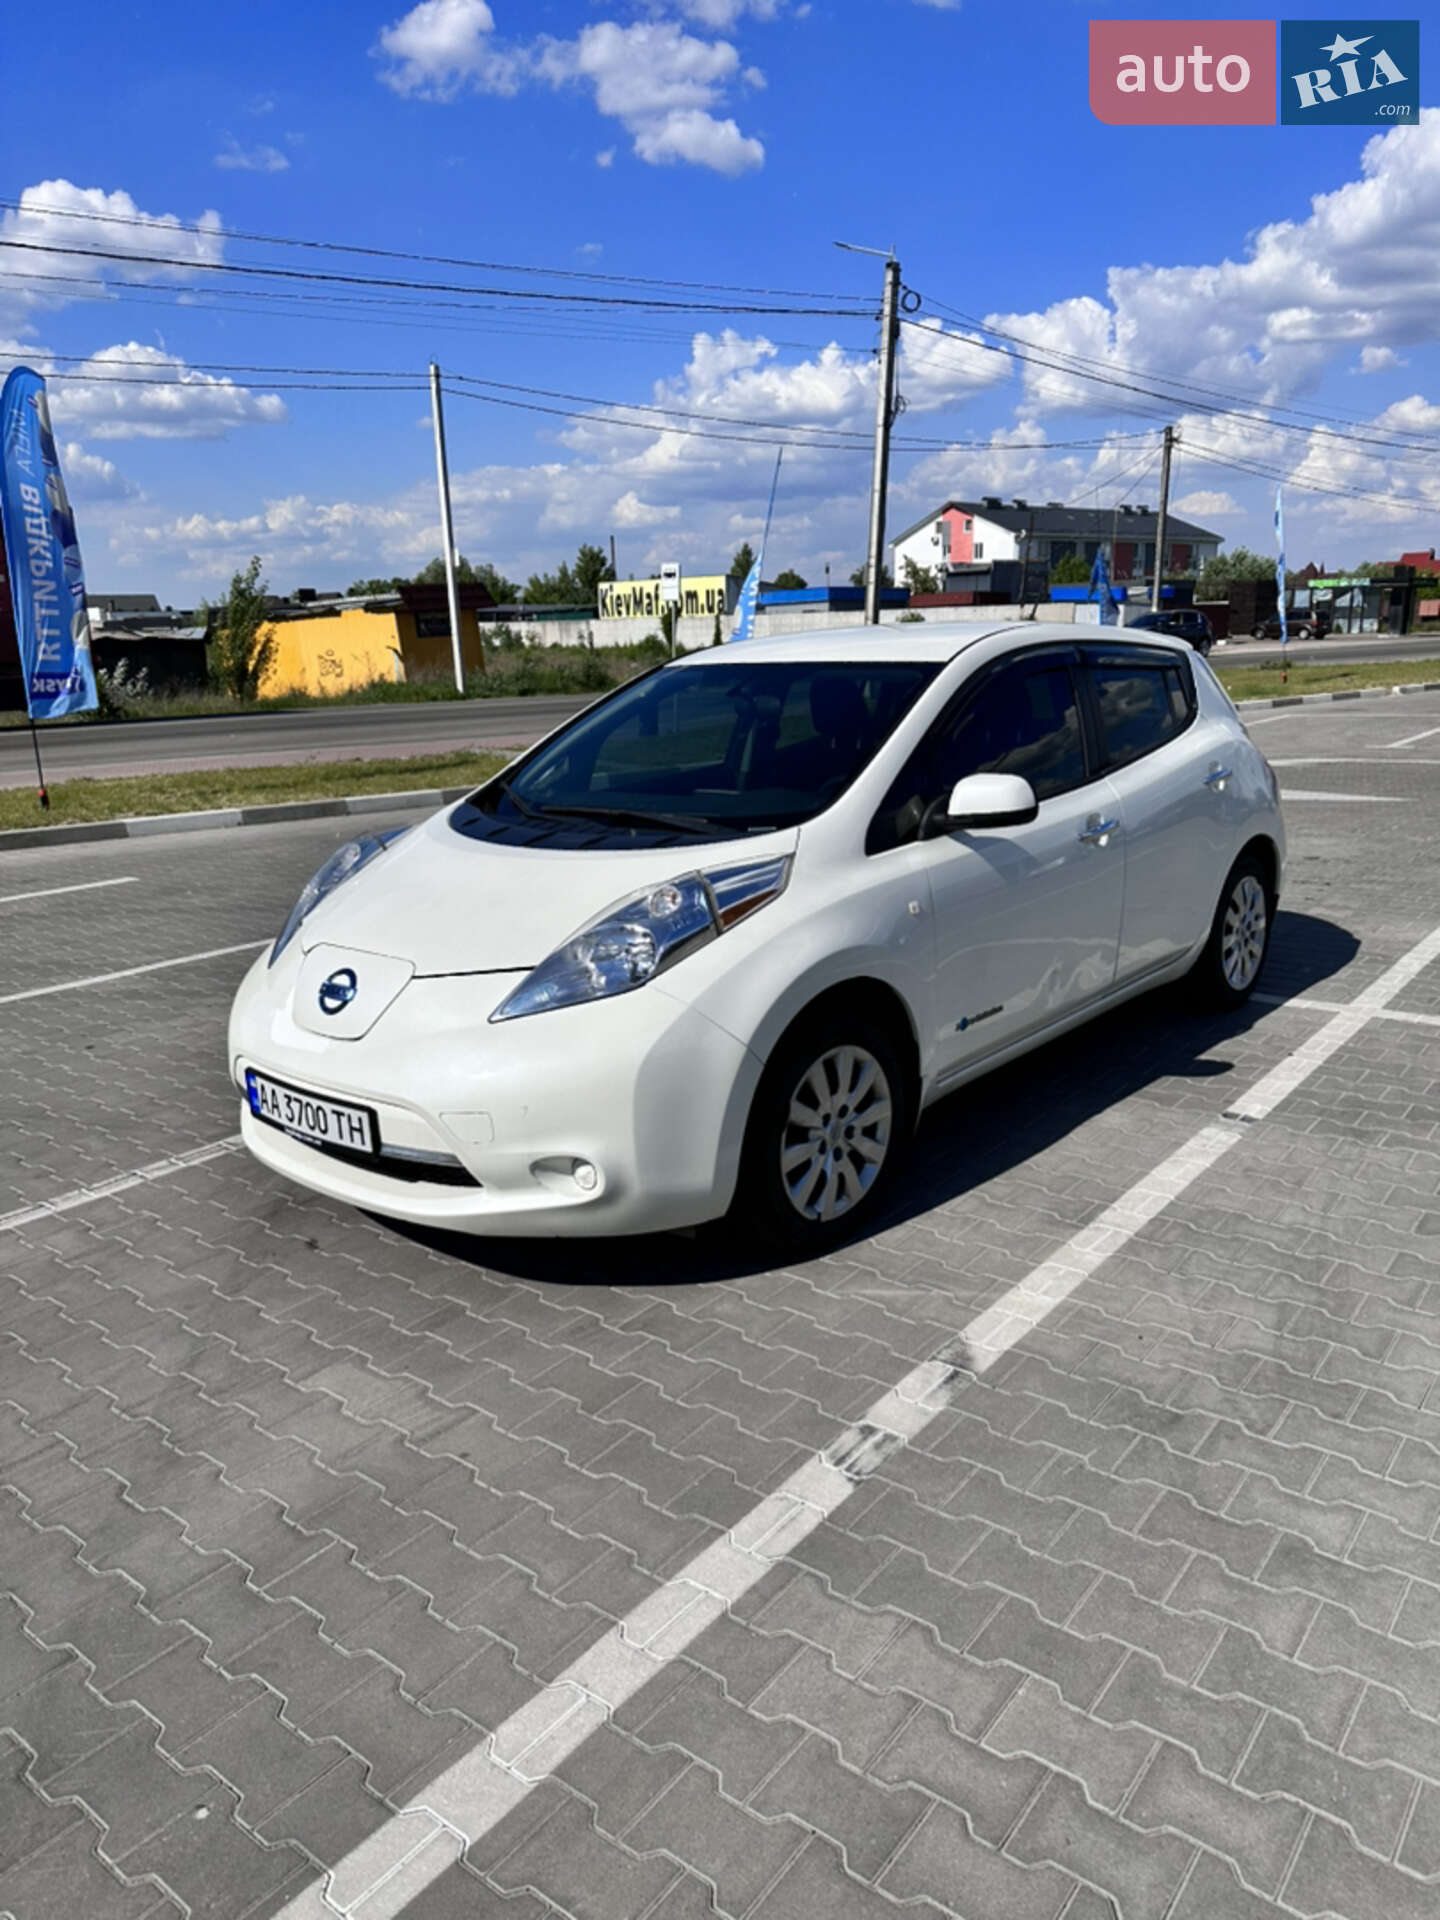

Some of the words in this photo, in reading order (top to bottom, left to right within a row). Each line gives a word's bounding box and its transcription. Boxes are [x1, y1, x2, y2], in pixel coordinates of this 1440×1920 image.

[260, 1083, 281, 1119] AA
[284, 1094, 329, 1135] 3700
[331, 1109, 367, 1146] TH
